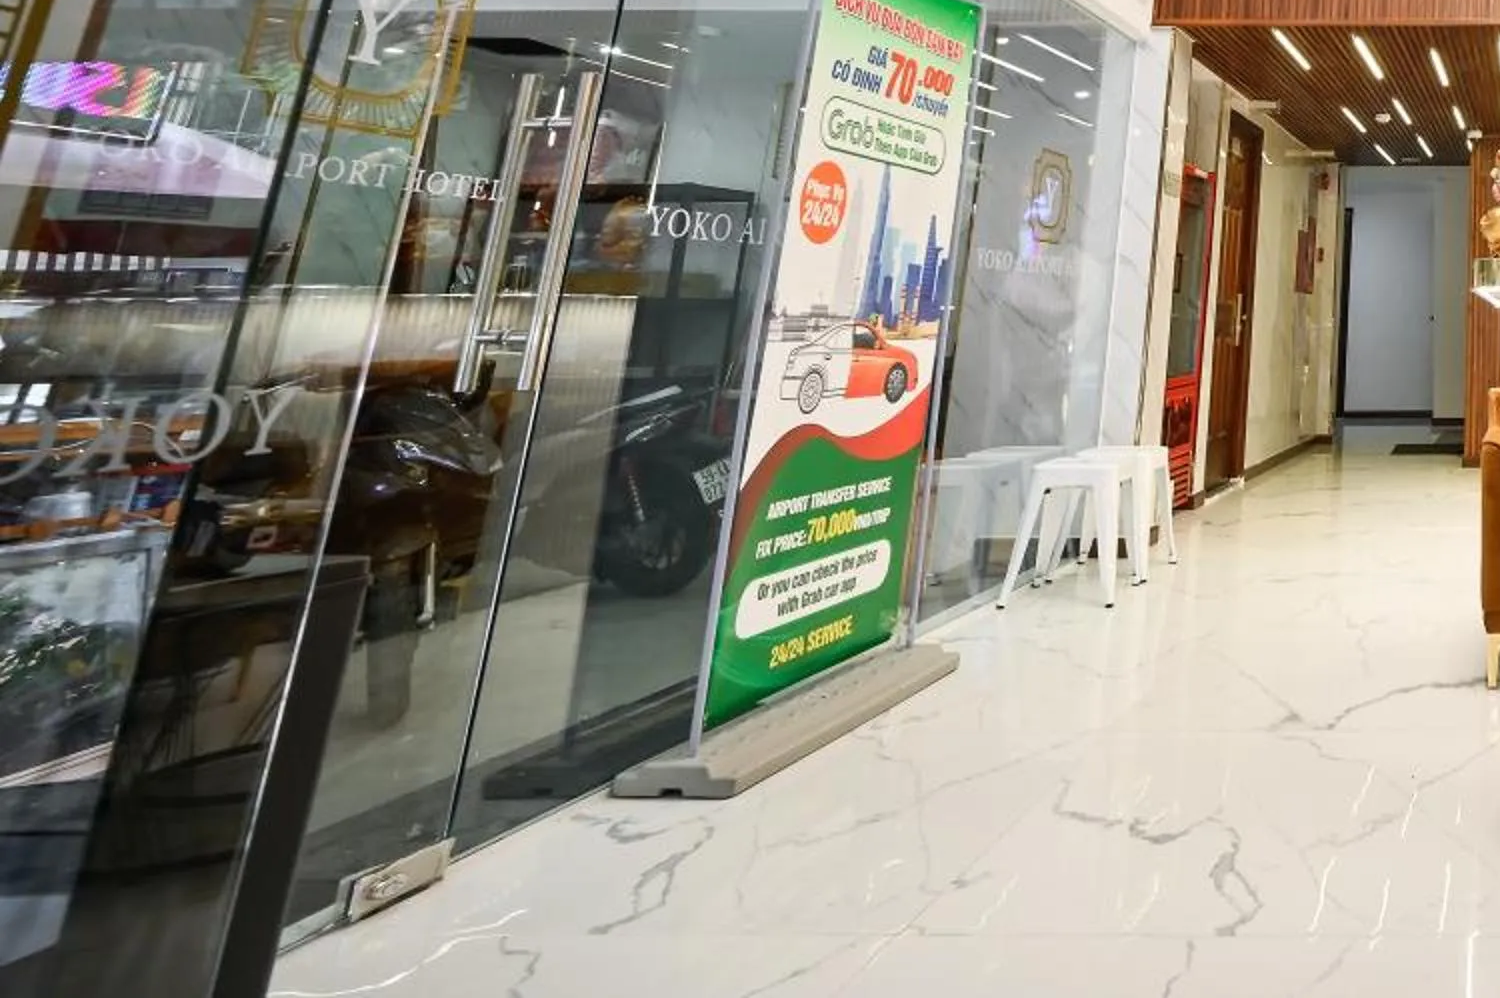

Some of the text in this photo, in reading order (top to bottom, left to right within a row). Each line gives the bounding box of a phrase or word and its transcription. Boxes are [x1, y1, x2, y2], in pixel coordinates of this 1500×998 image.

[831, 57, 855, 82] CỐ
[828, 109, 874, 149] Grab
[649, 205, 733, 242] YOKO
[767, 475, 893, 521] AIRPORT TRANSFER SERVICE
[757, 549, 879, 601] Or you can check the price
[777, 577, 857, 617] with Grab car app
[769, 614, 854, 670] 24/24 SERVICE
